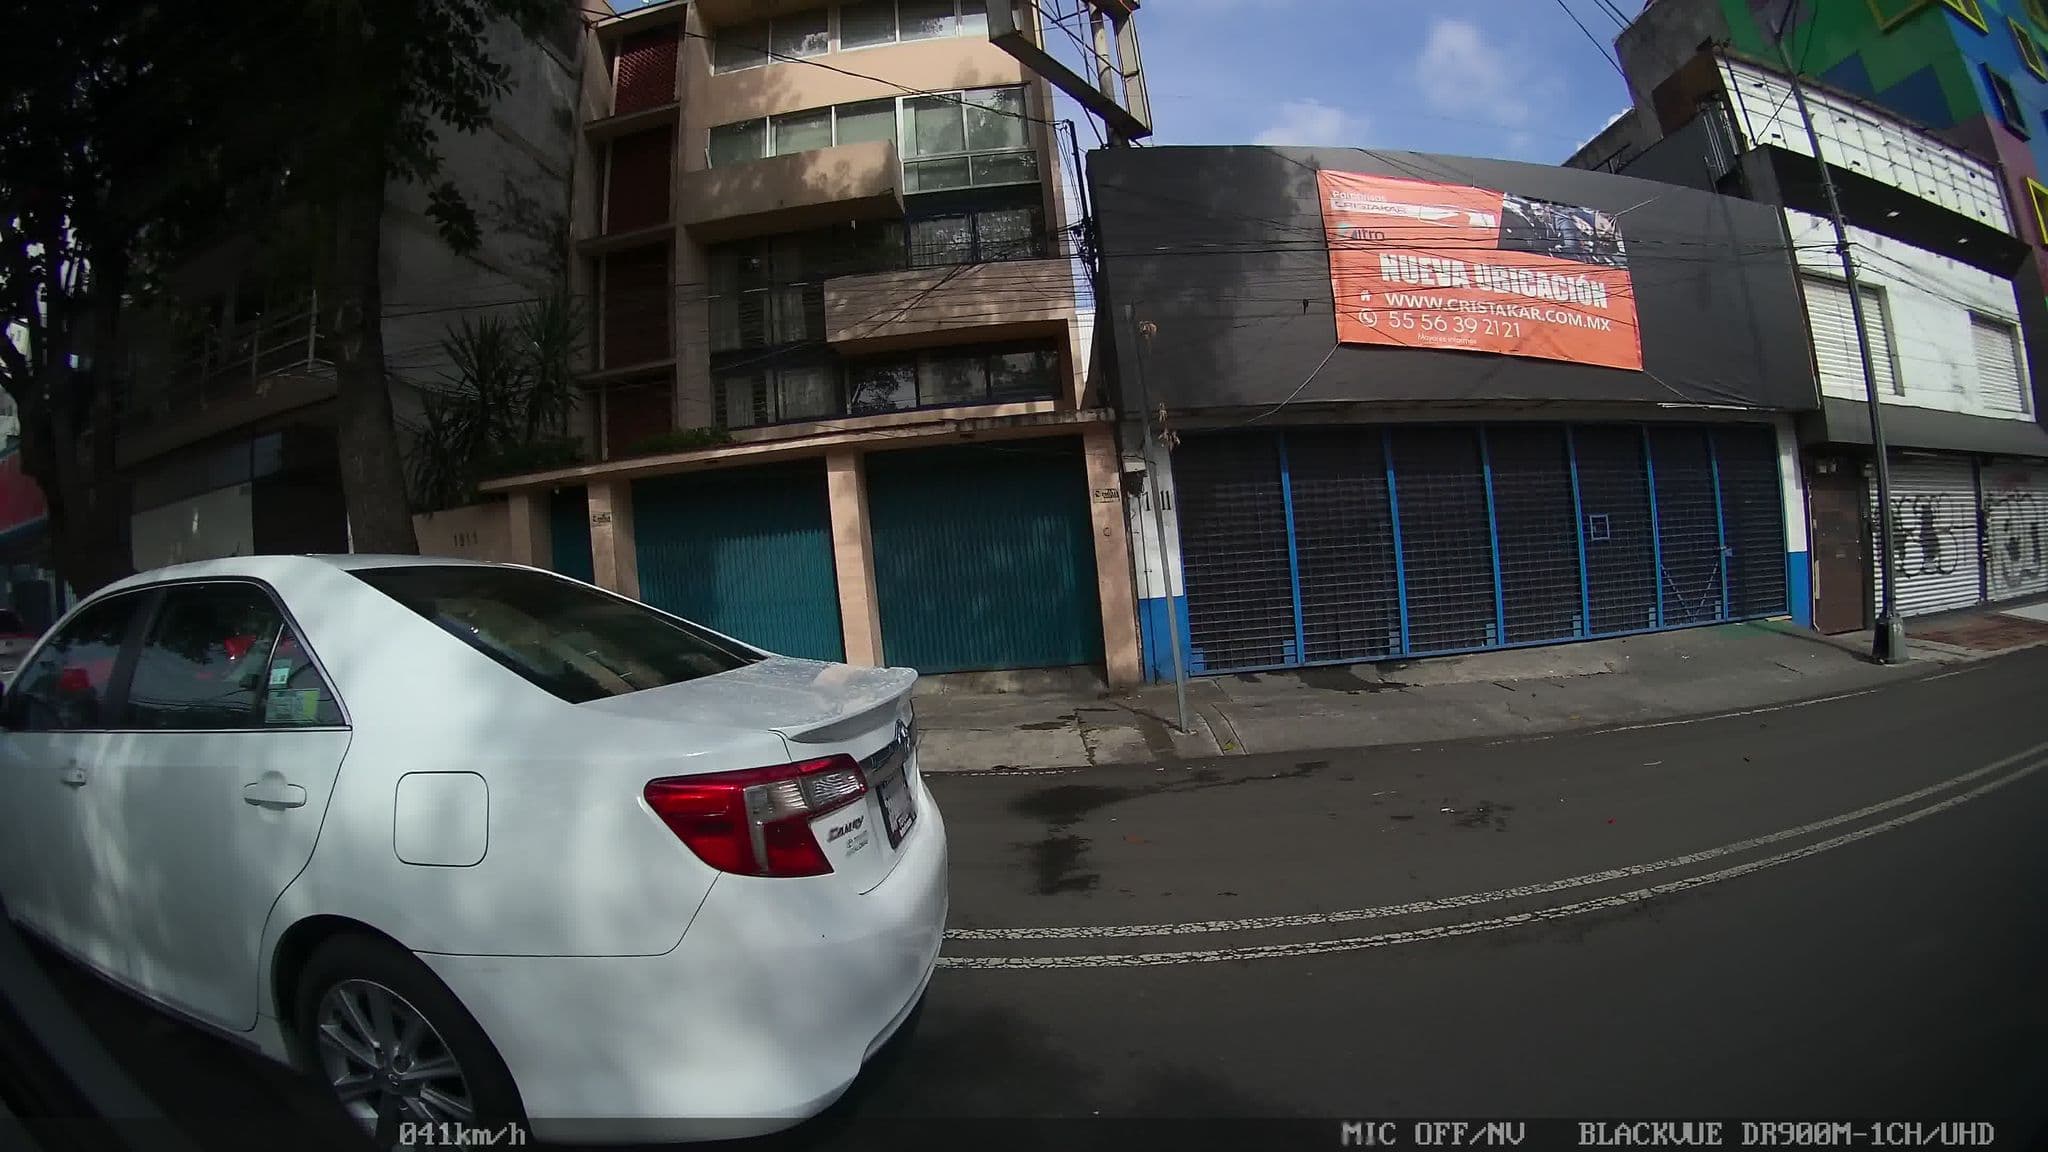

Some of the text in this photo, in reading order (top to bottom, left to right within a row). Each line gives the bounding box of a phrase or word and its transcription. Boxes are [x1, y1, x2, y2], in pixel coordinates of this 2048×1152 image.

[1379, 253, 1608, 309] NUEVA UBICACIÓN
[1384, 293, 1611, 332] WWW.CRISTAKAR.COM.MX
[1389, 311, 1414, 329] 55
[1421, 314, 1447, 332] 56
[1453, 316, 1478, 334] 39
